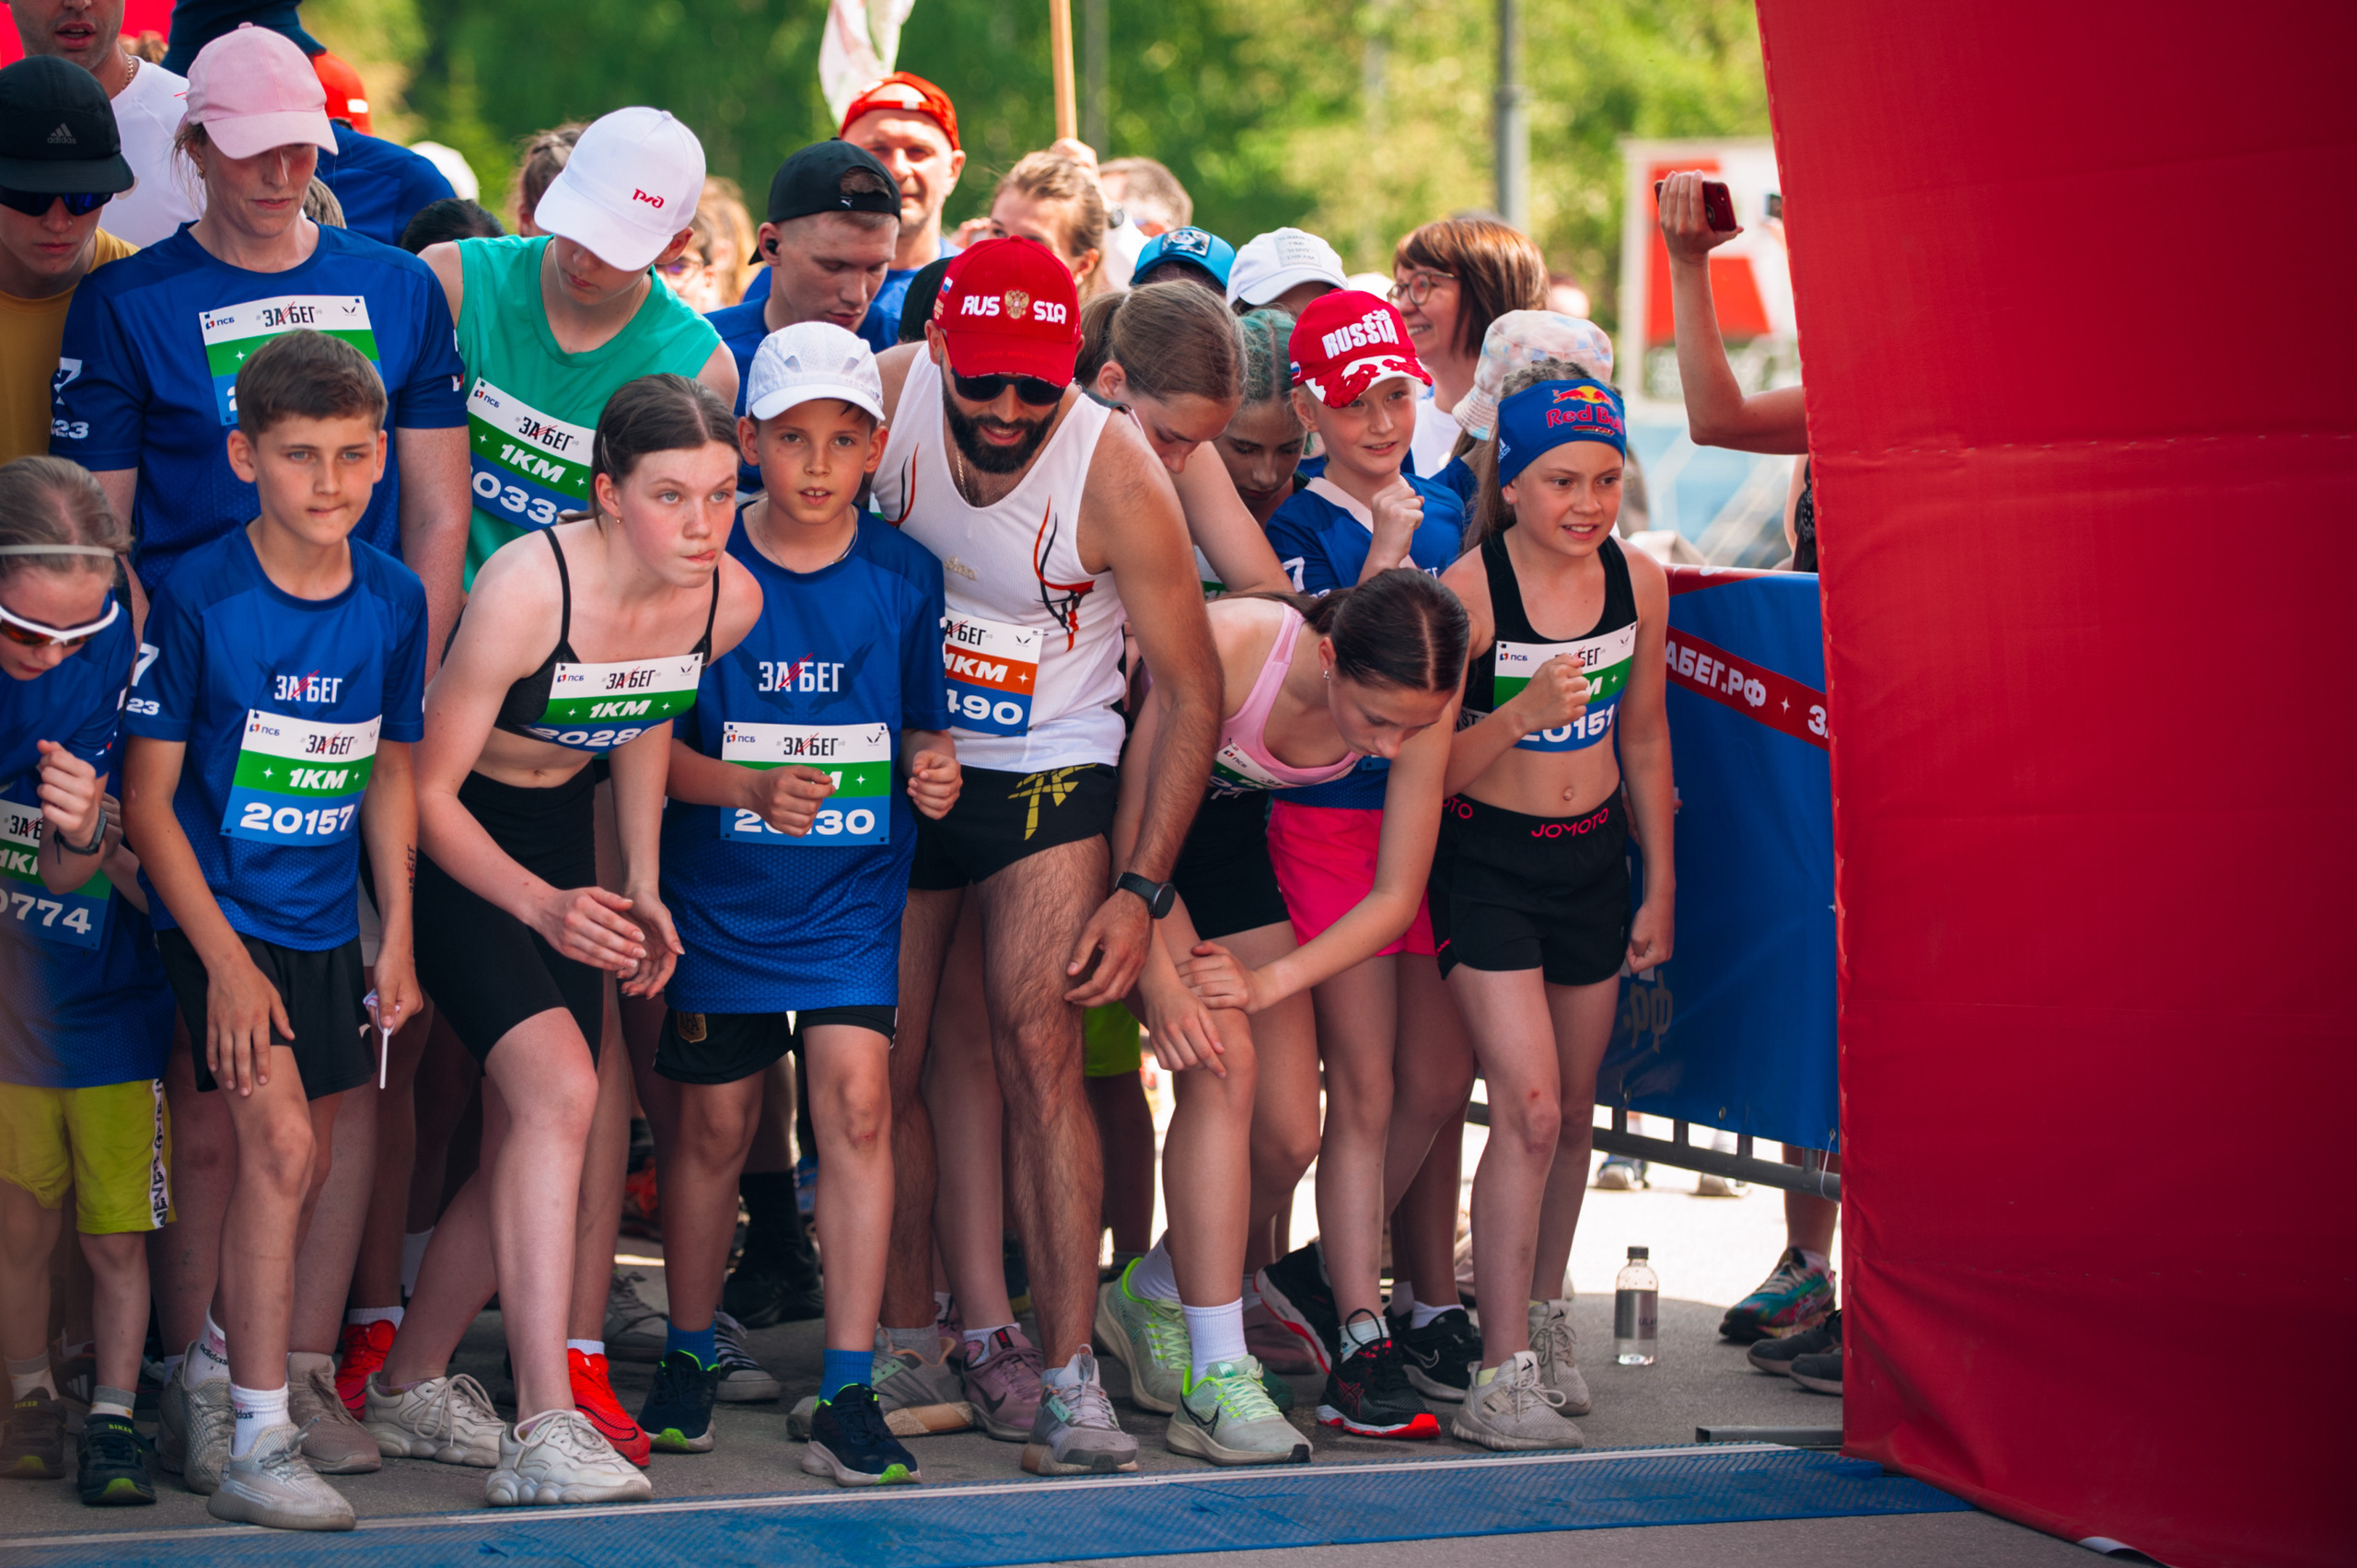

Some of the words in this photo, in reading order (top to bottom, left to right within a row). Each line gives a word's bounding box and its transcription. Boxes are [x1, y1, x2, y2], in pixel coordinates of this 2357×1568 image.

[961, 296, 1001, 316] RUS
[1033, 300, 1067, 324] SIA
[216, 317, 235, 326] ПСБ
[1321, 319, 1399, 360] RUSSIA
[483, 394, 501, 409] ПСБ
[1545, 403, 1593, 429] Red
[470, 465, 579, 525] 033
[1510, 654, 1528, 662] ПСБ
[261, 726, 280, 737] ПСБ
[530, 726, 657, 748] 2028
[239, 802, 355, 835] 20157
[734, 808, 876, 836] 230
[14, 1400, 39, 1409] BIKER
[109, 1423, 134, 1434] BIKER
